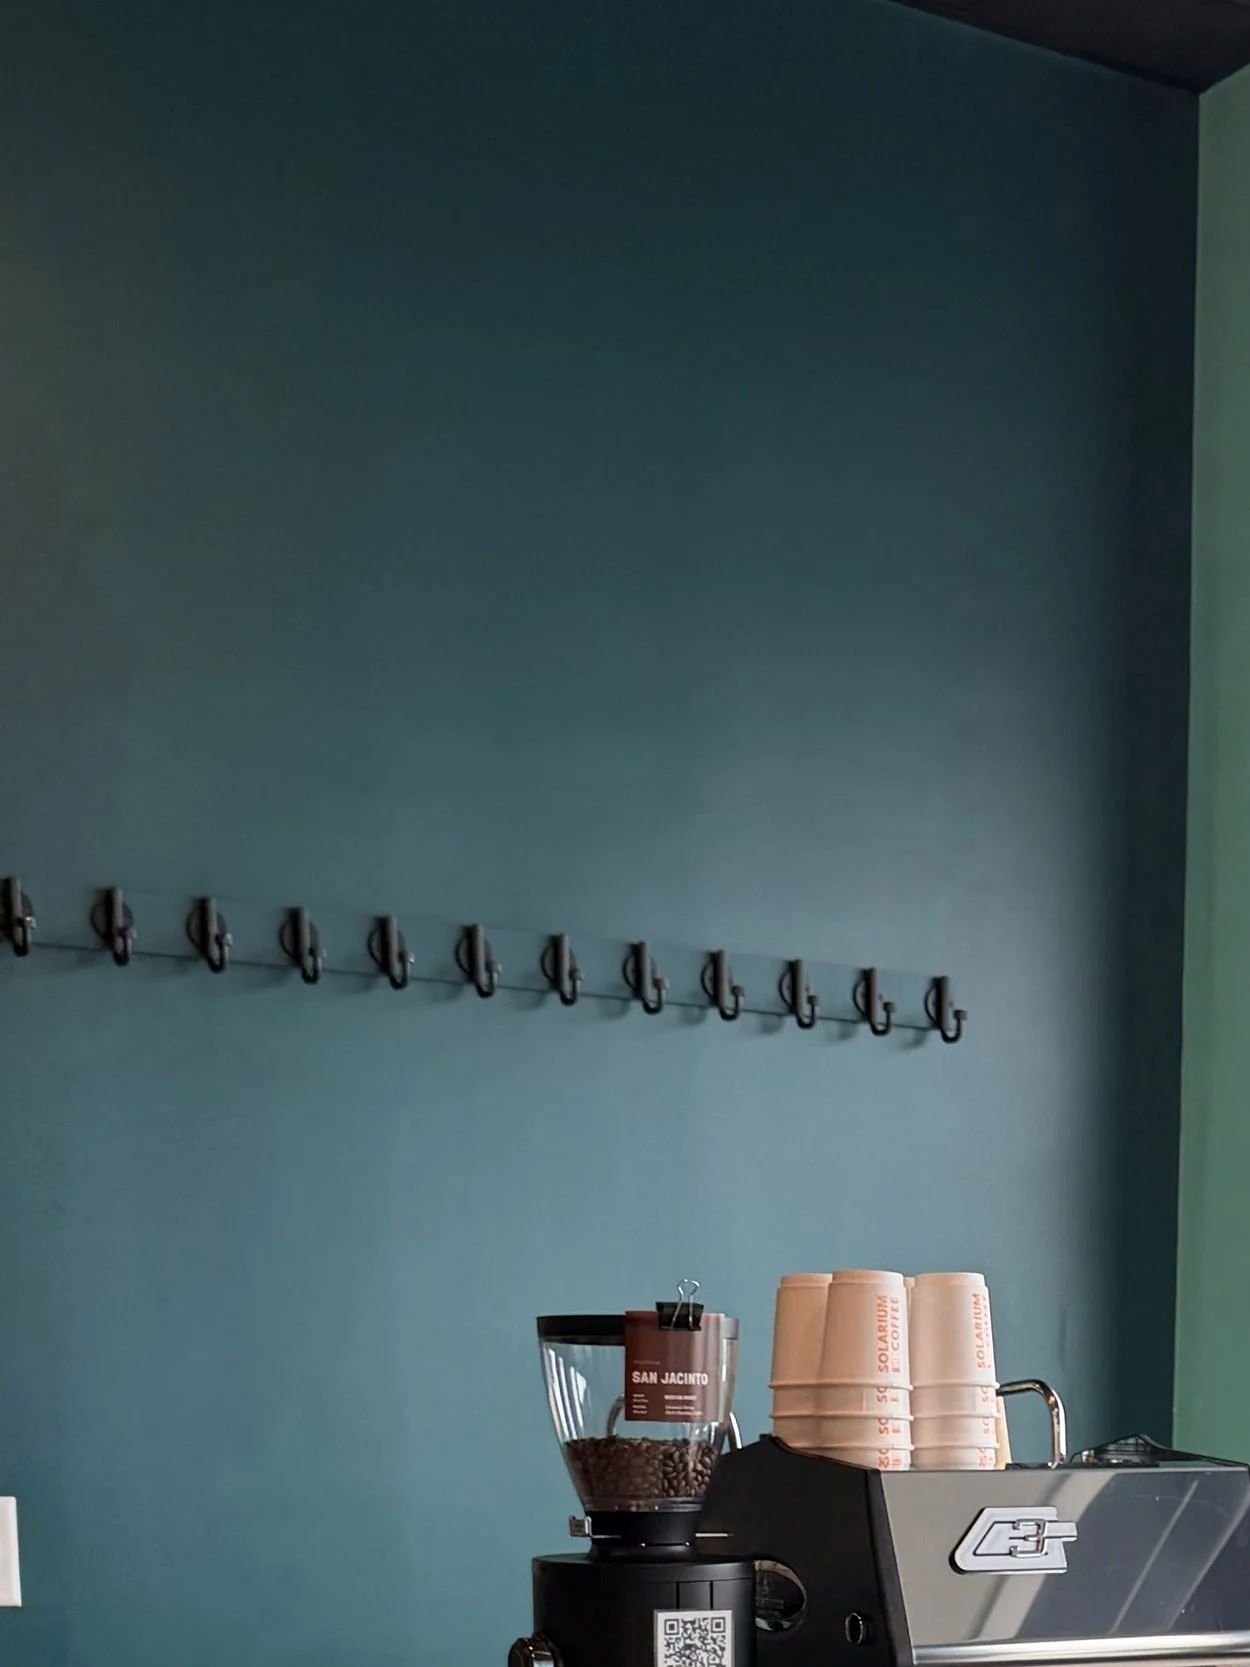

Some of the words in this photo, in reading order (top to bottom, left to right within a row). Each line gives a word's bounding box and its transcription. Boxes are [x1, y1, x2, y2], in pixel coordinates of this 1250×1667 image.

[876, 1295, 889, 1373] SOLARIUM
[972, 1293, 986, 1368] SOLARIUM
[632, 1370, 658, 1385] SAN
[660, 1371, 709, 1386] JACINTO
